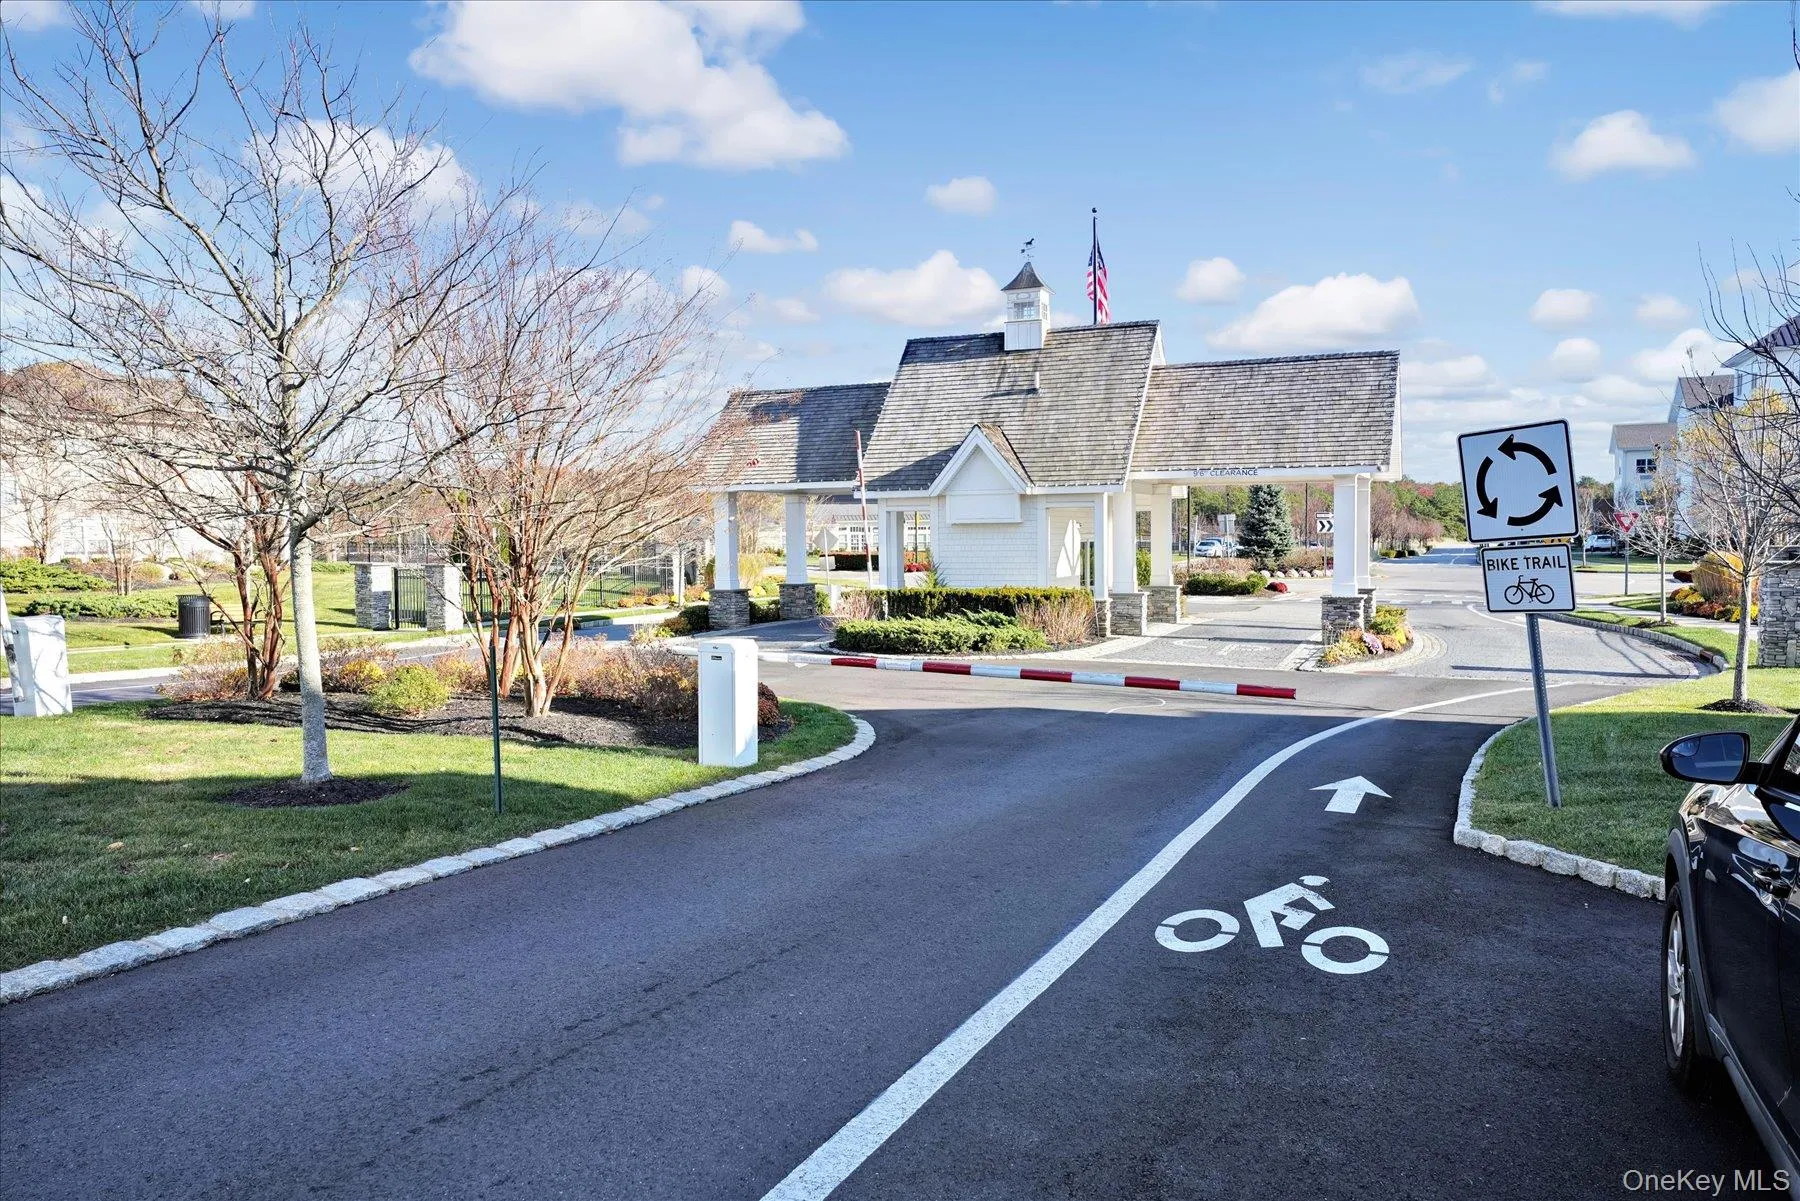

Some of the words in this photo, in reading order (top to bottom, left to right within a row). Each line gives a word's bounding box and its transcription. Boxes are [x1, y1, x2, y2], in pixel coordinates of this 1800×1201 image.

[1210, 469, 1258, 477] CLEARANCE
[1487, 557, 1520, 571] BIKE
[1523, 555, 1567, 569] TRAIL
